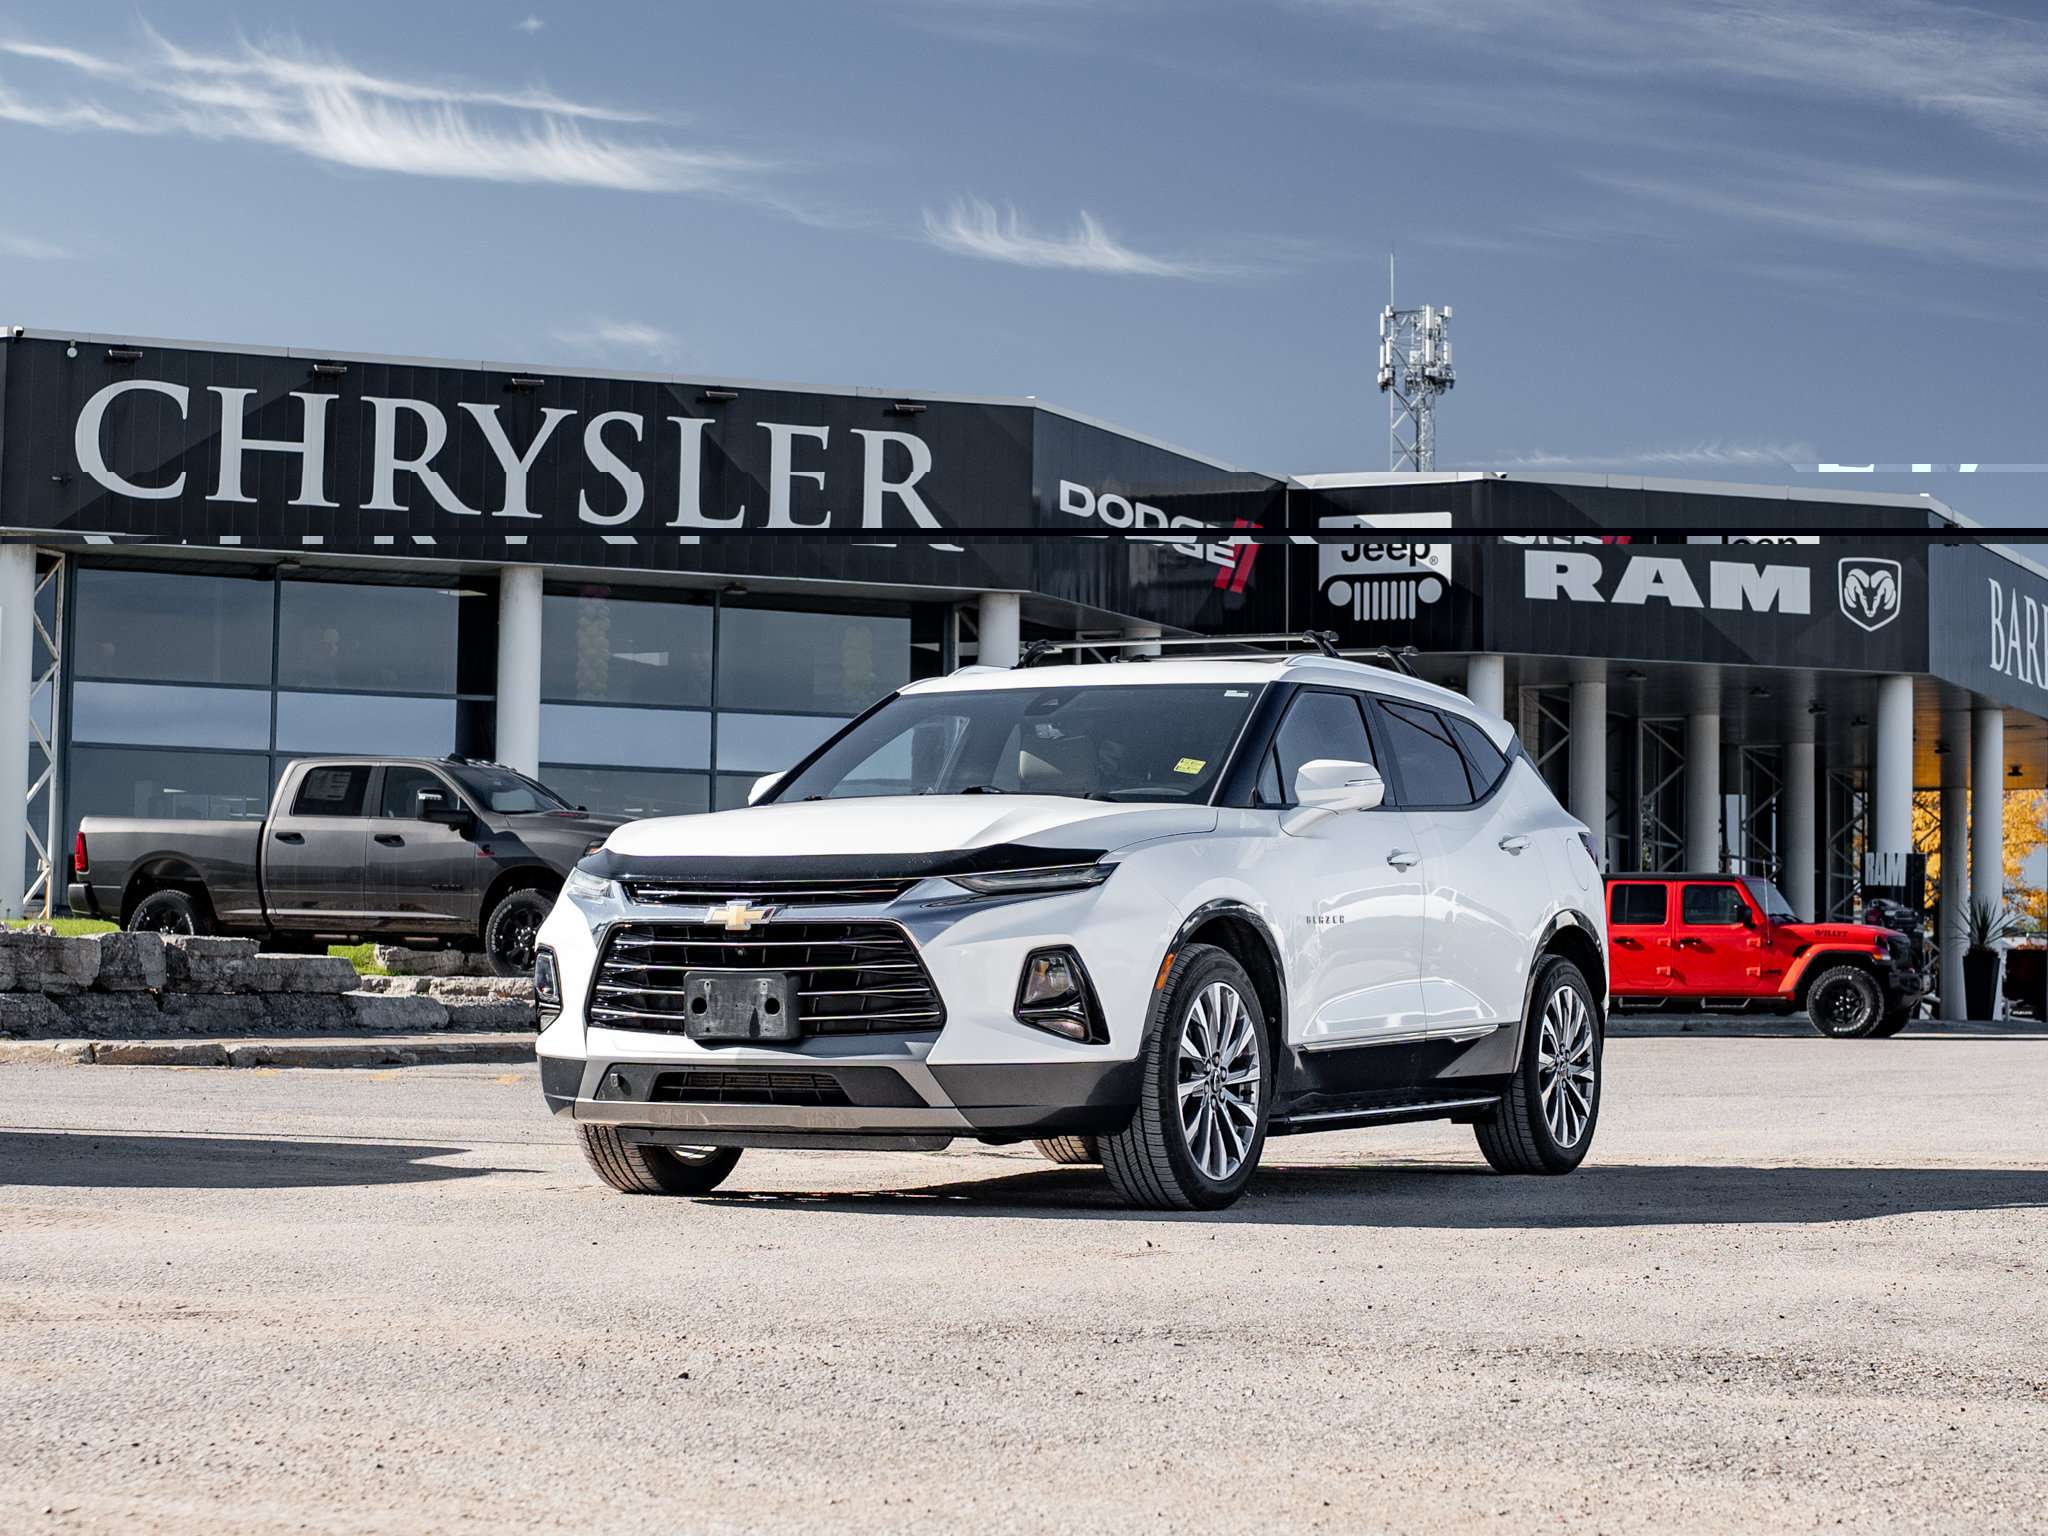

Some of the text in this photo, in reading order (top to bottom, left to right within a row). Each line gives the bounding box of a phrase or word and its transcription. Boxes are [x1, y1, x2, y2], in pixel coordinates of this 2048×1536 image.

[74, 379, 963, 552] CHRYSLER
[1524, 549, 1811, 615] RAM
[1988, 577, 2048, 691] BAR
[1865, 852, 1906, 887] RAM
